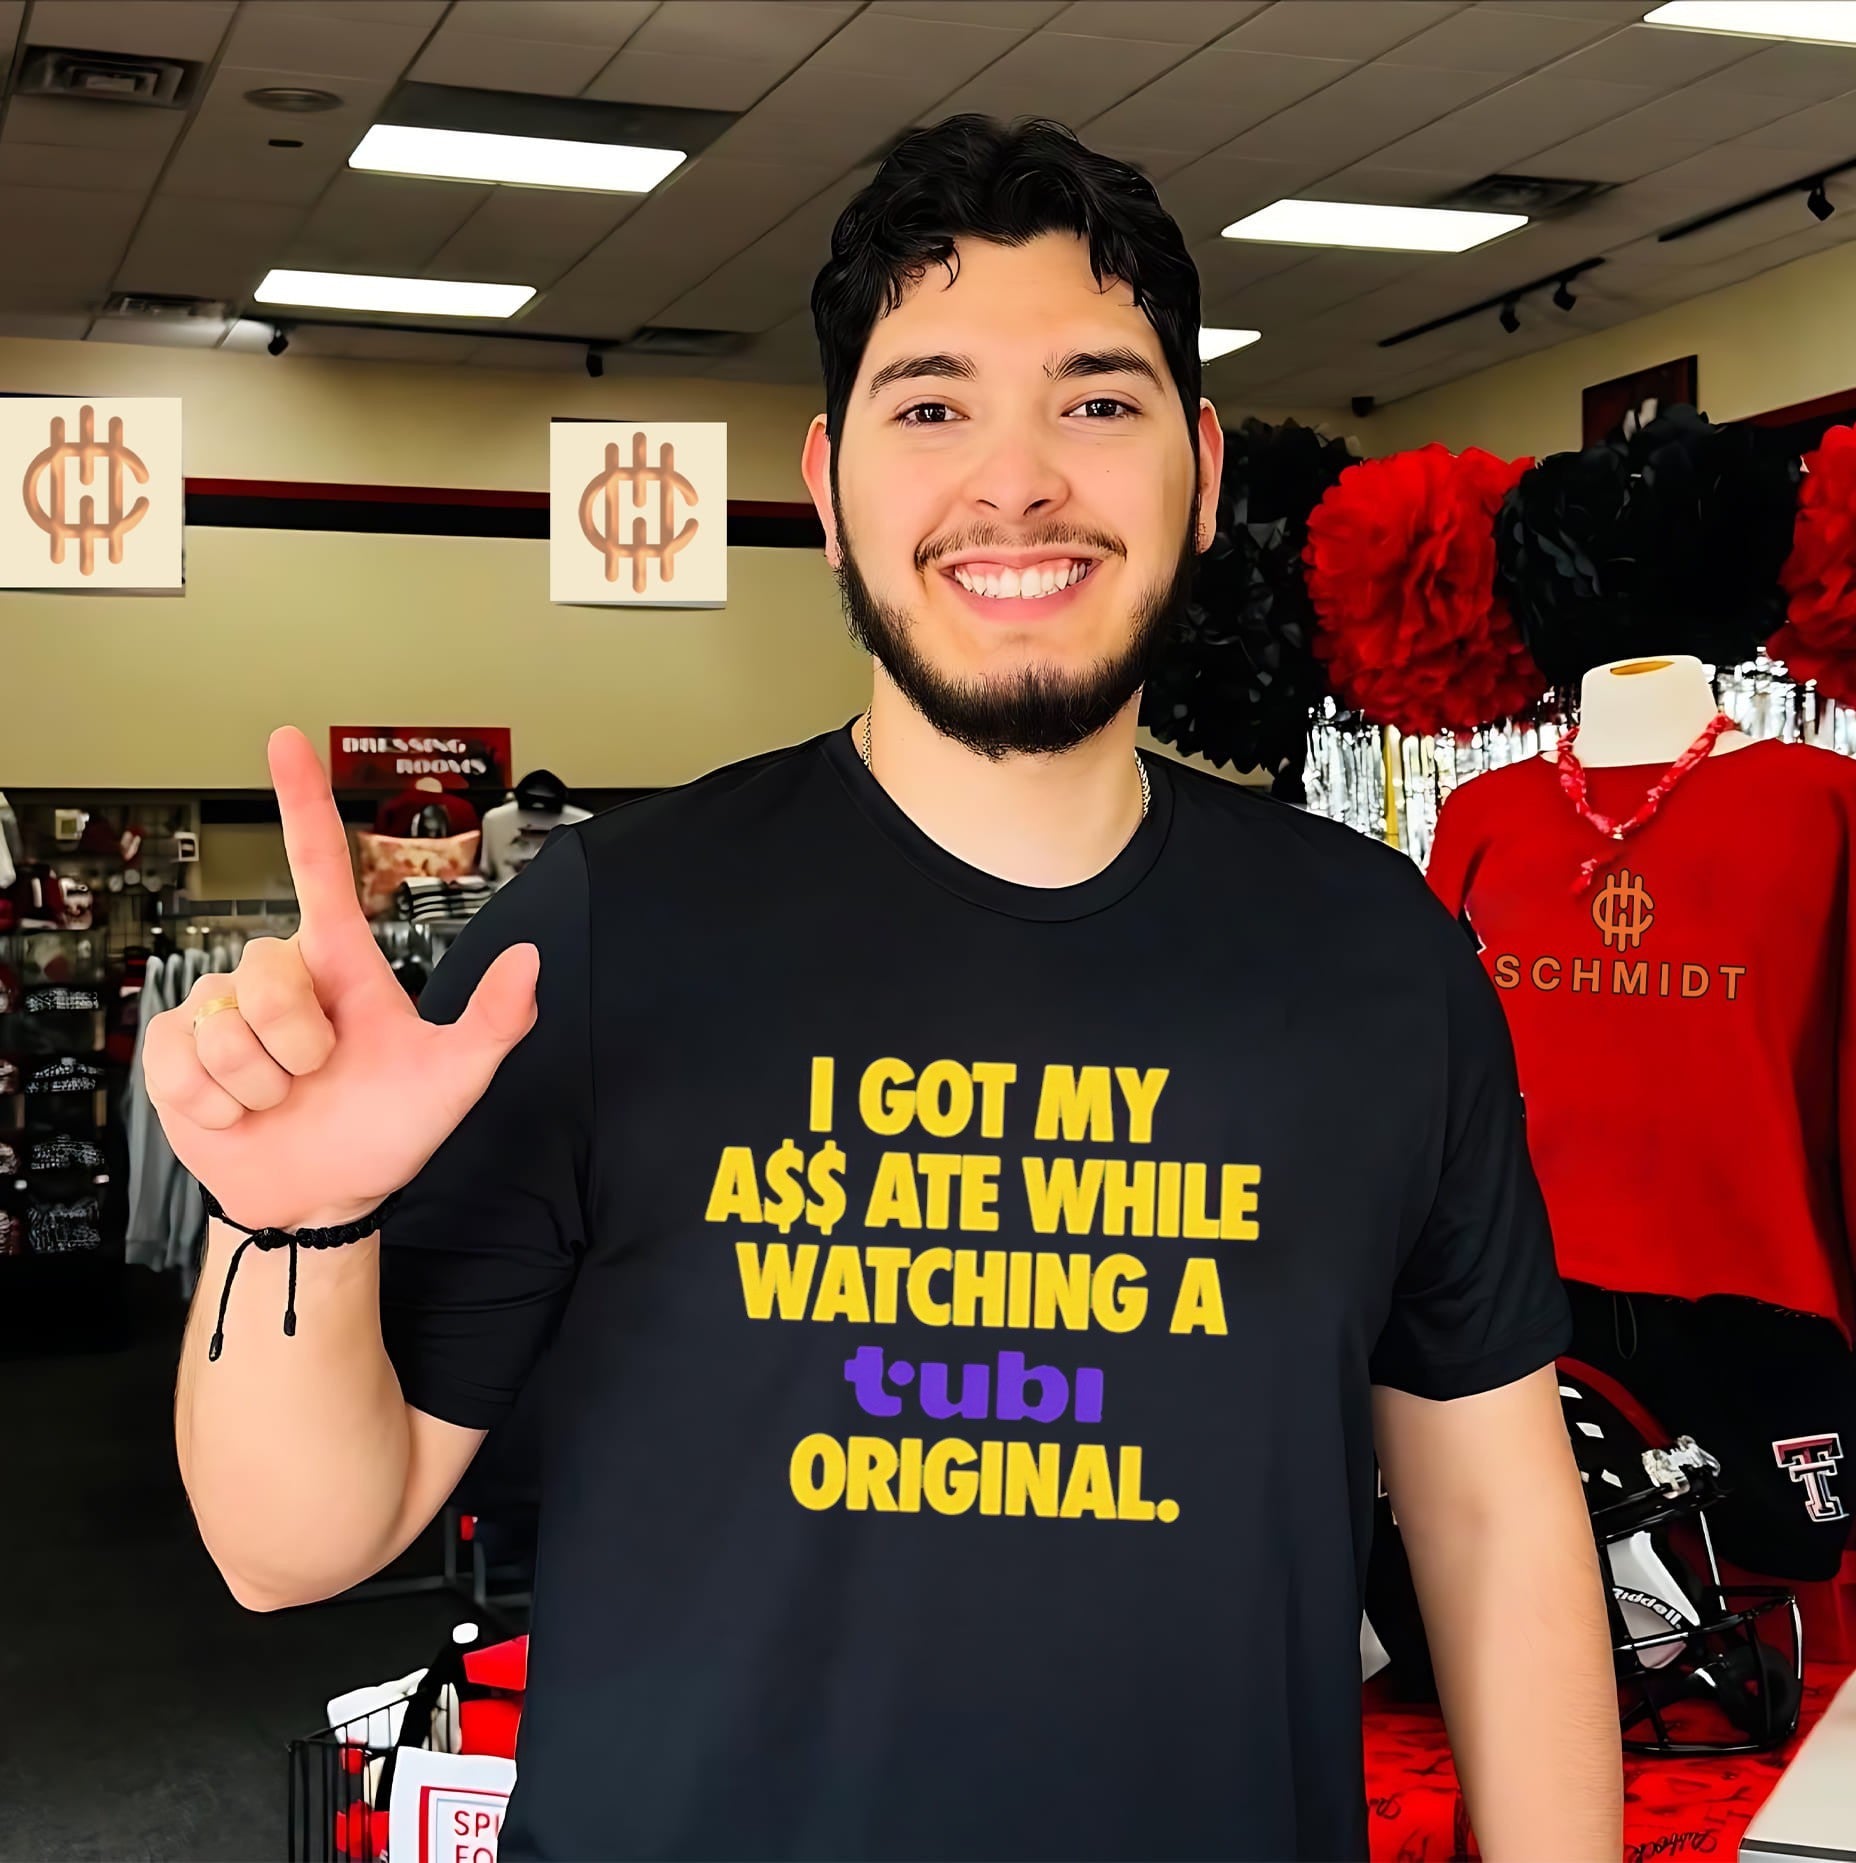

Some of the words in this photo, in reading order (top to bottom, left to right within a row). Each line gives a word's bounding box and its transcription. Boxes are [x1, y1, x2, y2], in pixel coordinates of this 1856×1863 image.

[396, 758, 487, 775] ROOMS
[1494, 954, 1746, 1000] SCHMIDT
[809, 1056, 834, 1133] I
[859, 1057, 1017, 1138] GOT
[1034, 1064, 1170, 1144] MY
[705, 1138, 847, 1236] A$$
[864, 1152, 1001, 1231] ATE
[1021, 1157, 1261, 1240] WHILE
[735, 1242, 1149, 1333] WATCHING
[1169, 1257, 1228, 1336] A
[844, 1345, 1104, 1423] tubi
[789, 1433, 1180, 1523] ORIGINAL.
